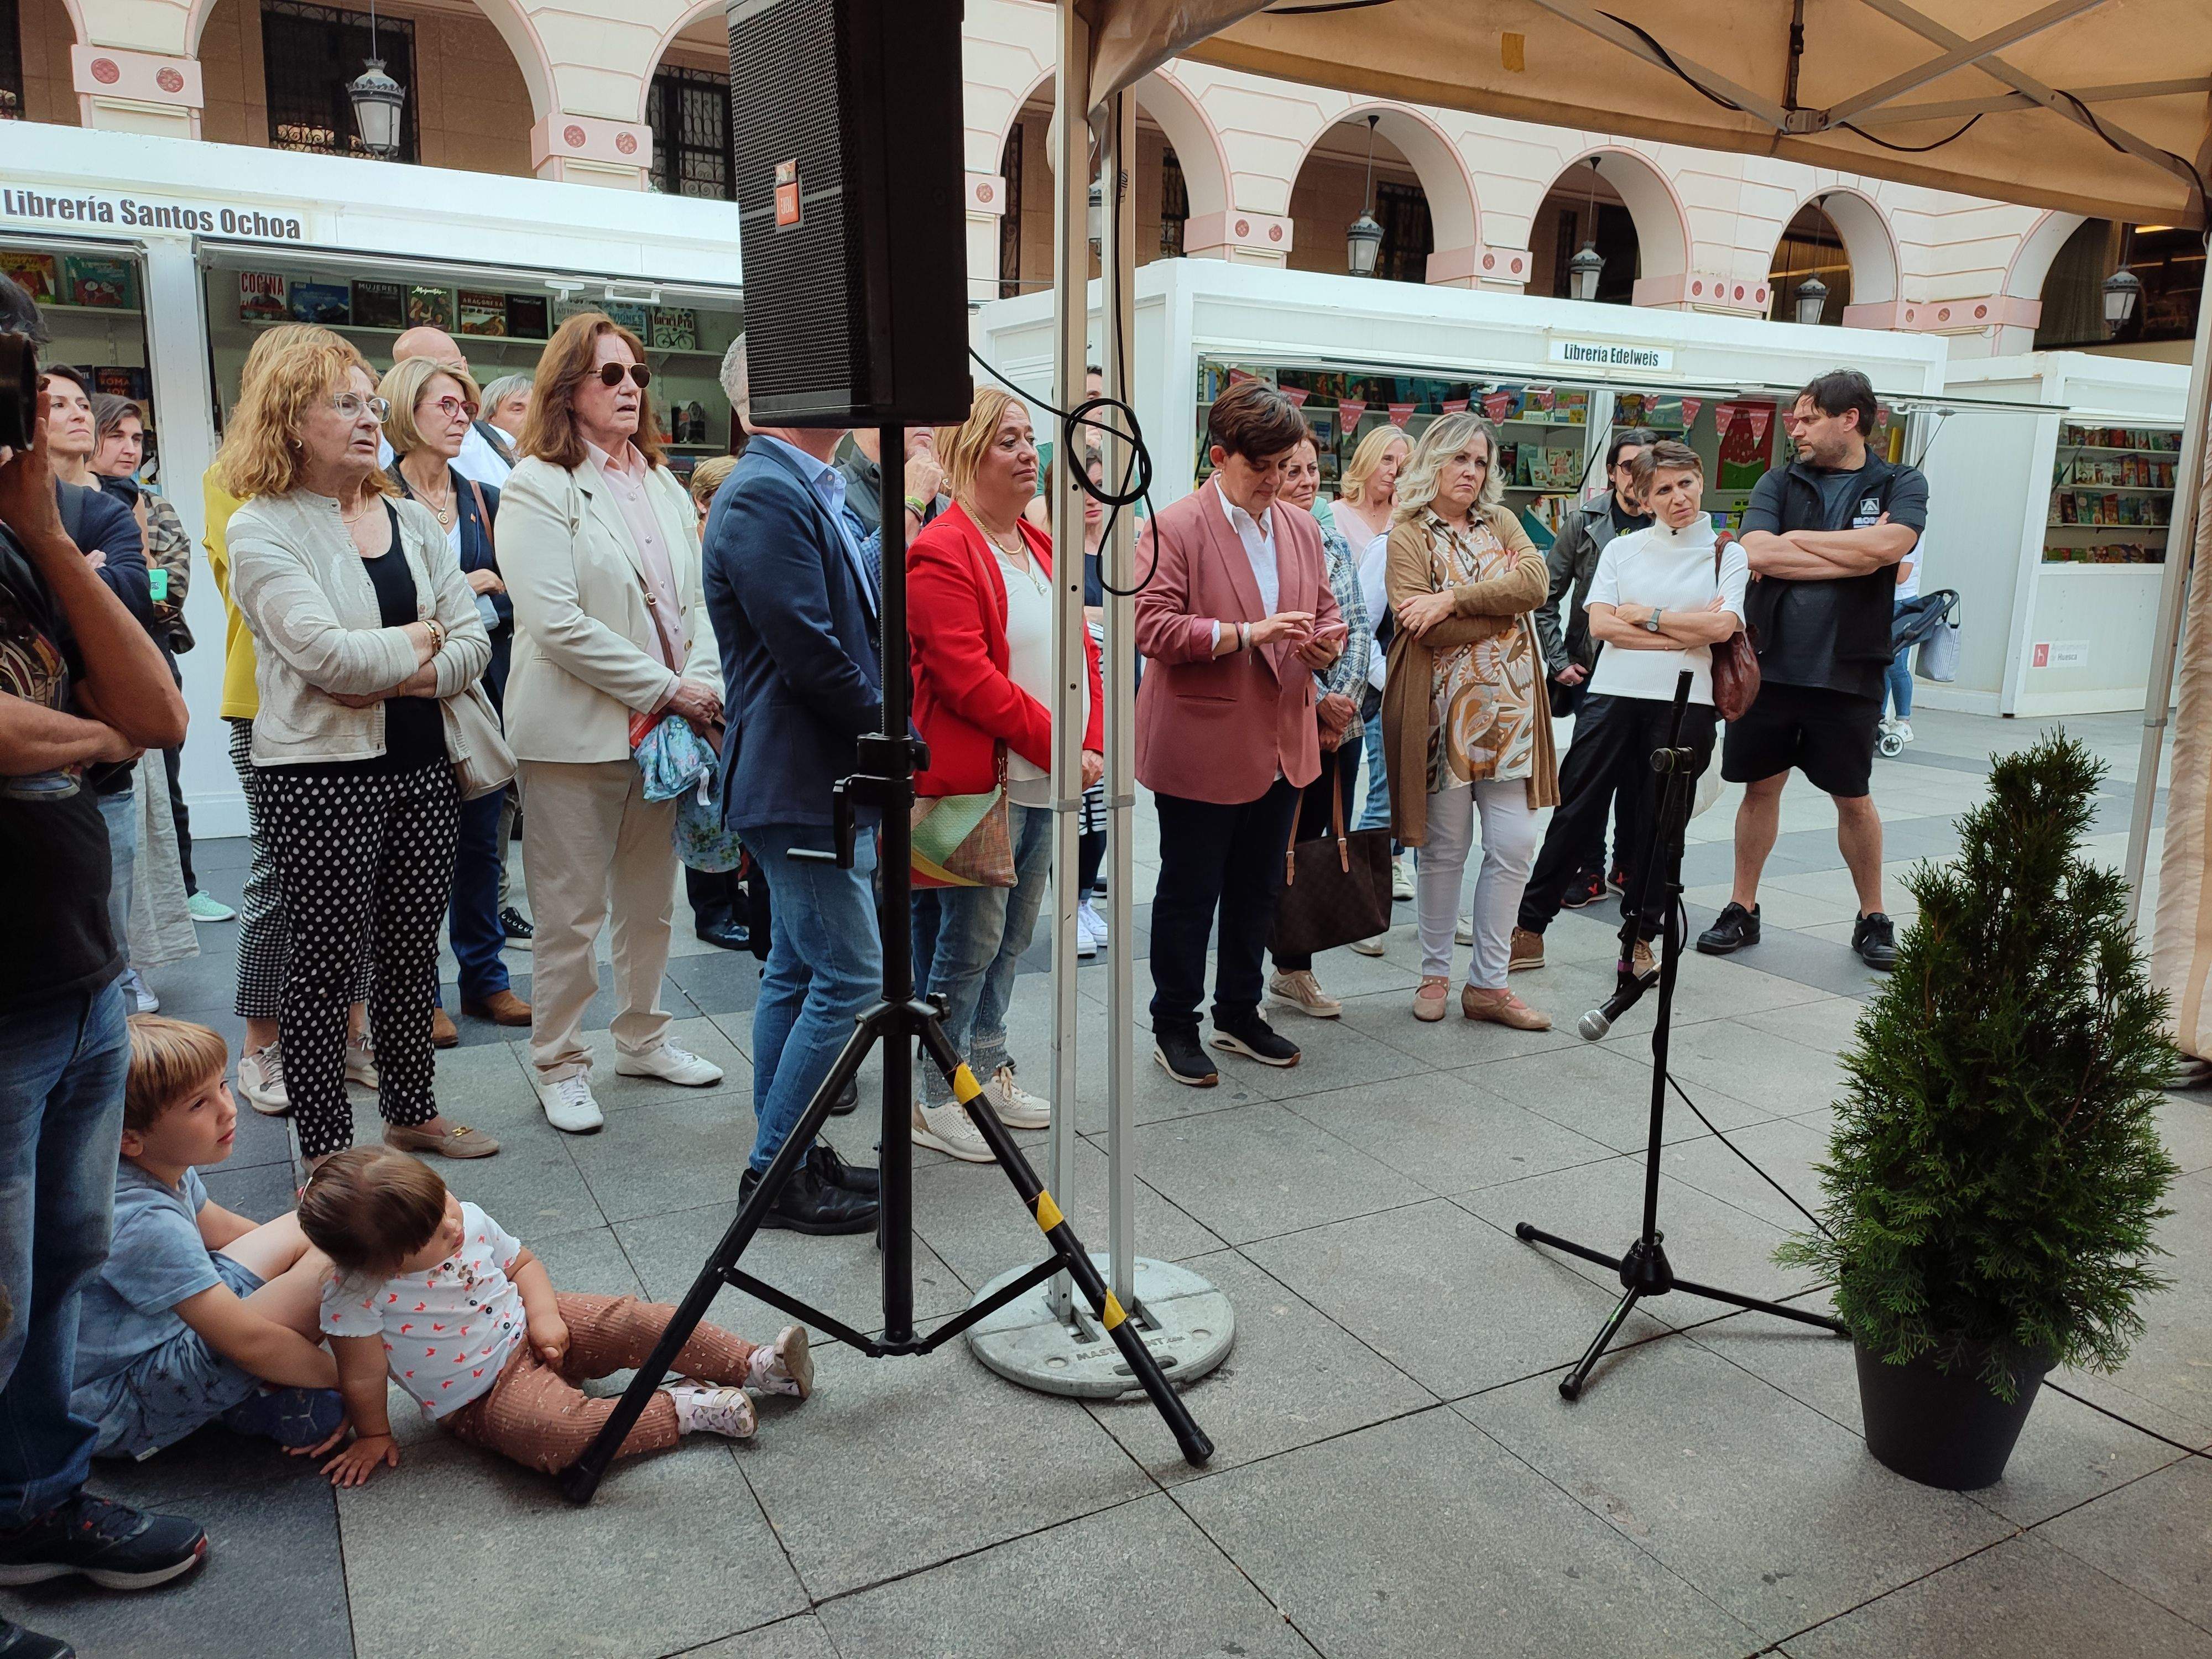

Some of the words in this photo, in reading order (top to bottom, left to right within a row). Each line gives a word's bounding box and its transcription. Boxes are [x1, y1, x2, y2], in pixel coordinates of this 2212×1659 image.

[3, 189, 114, 223] Librería
[120, 199, 214, 231] Santos
[220, 208, 301, 239] Ochoa
[780, 196, 794, 215] JBL
[358, 283, 398, 293] MUJERES
[1564, 343, 1608, 362] Librería
[1610, 347, 1659, 366] Edelweis
[100, 378, 131, 386] ROMA
